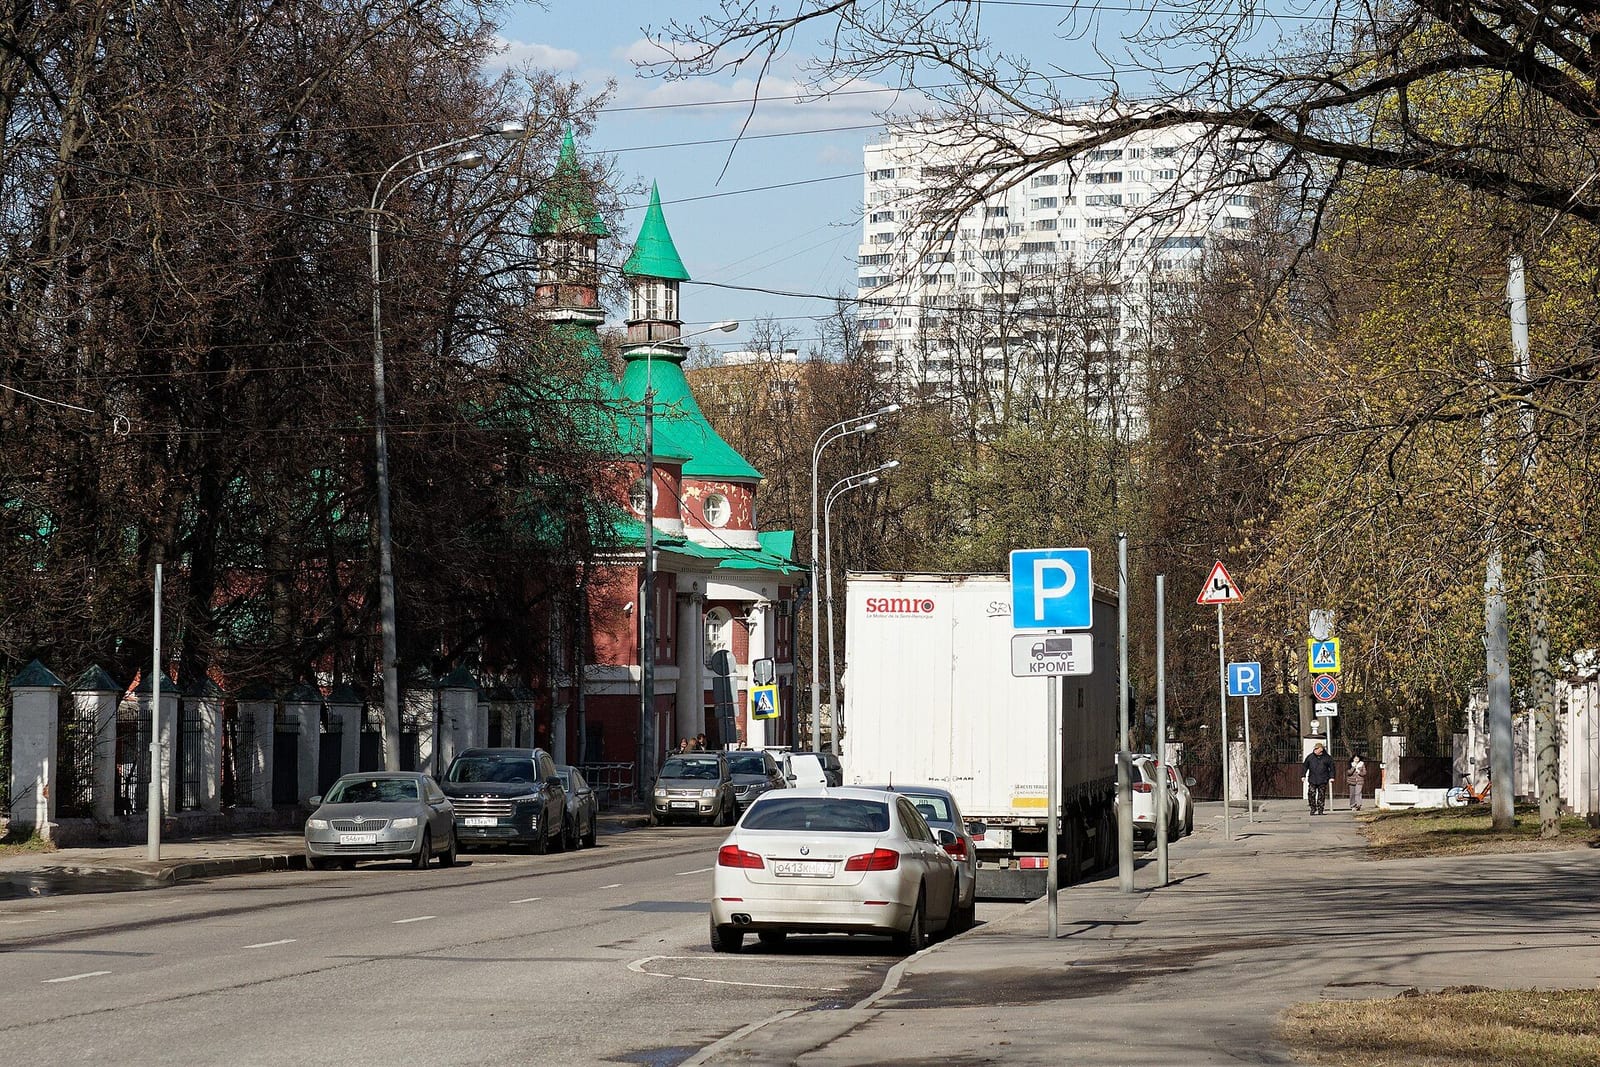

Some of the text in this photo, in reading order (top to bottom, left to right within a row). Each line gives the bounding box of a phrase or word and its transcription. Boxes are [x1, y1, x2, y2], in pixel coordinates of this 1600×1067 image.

[1033, 558, 1076, 621] P
[866, 598, 935, 613] samro
[1029, 661, 1075, 673] КРОМЕ
[1236, 666, 1255, 692] P
